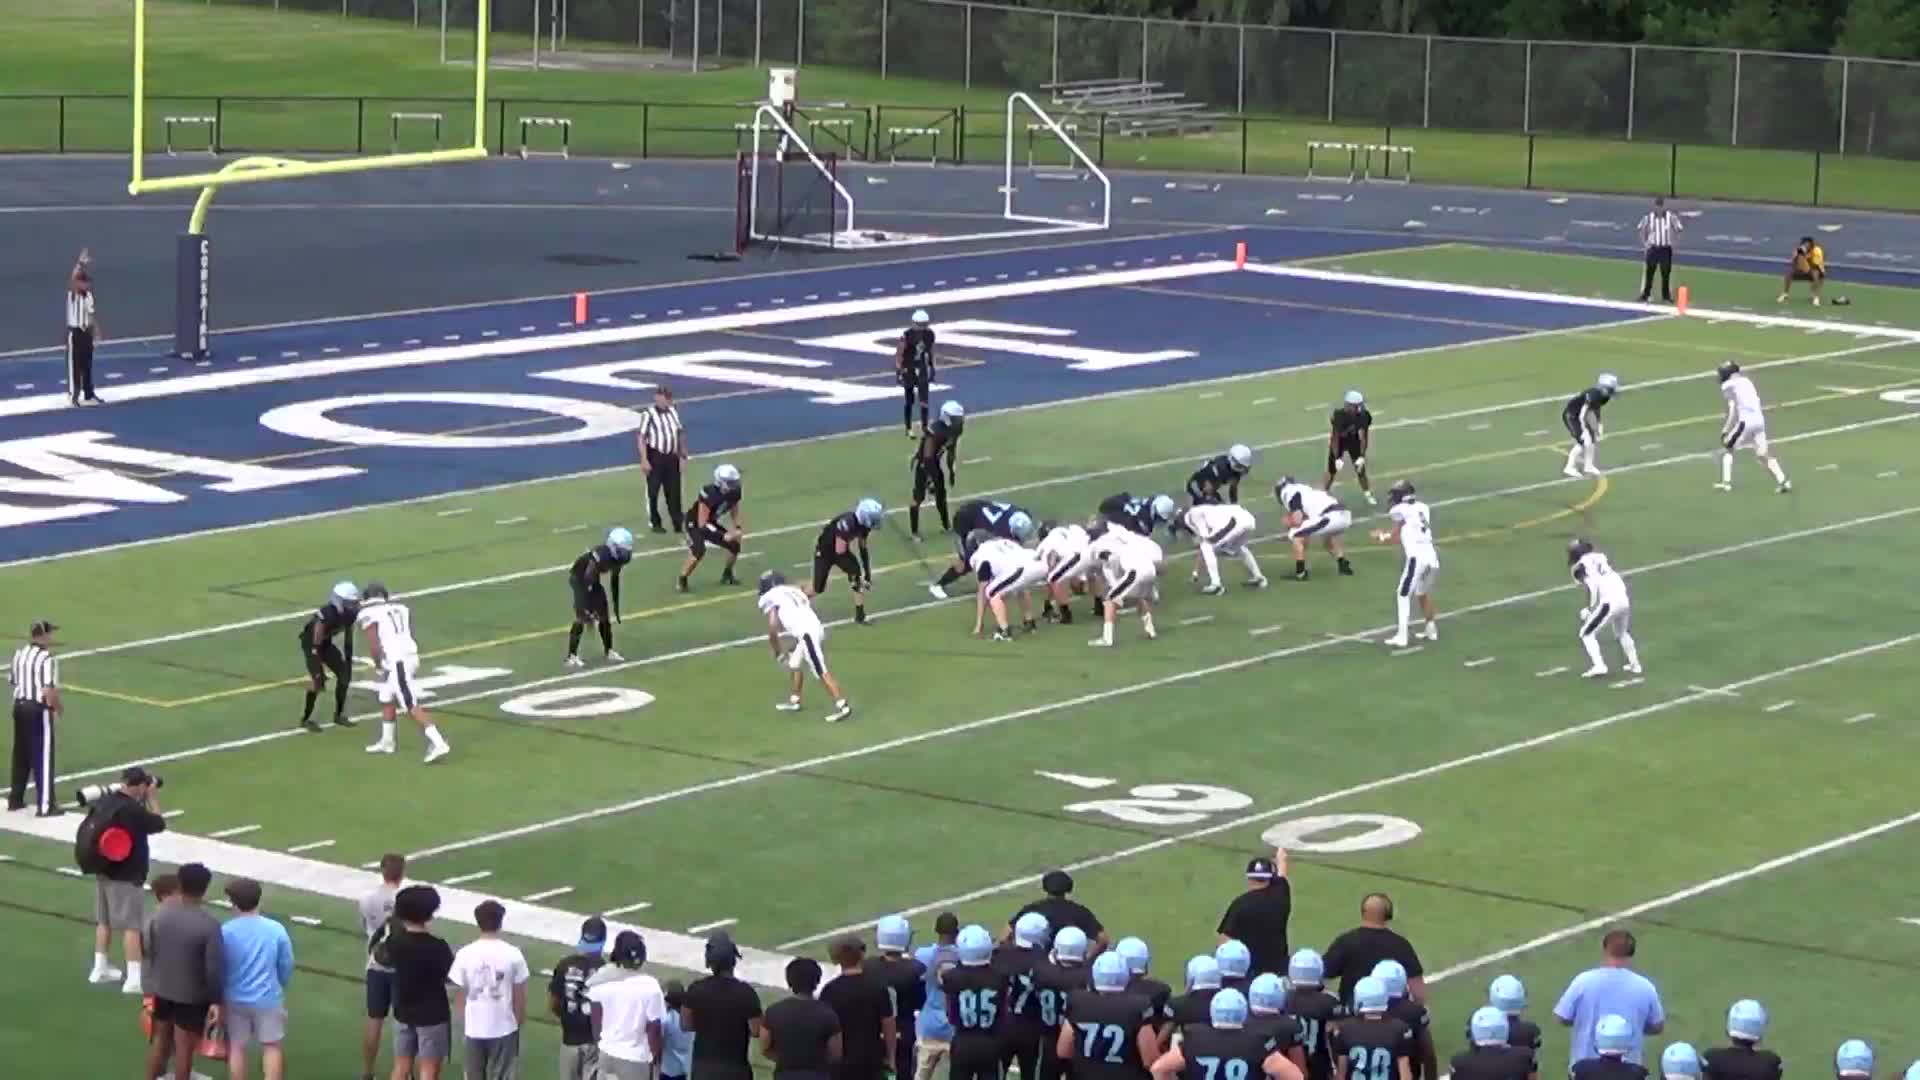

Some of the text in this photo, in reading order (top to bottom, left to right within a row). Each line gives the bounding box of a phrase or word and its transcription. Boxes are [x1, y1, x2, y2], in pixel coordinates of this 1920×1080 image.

[1063, 783, 1422, 853] 20
[958, 989, 998, 1029] 85
[1076, 1022, 1125, 1064] 72
